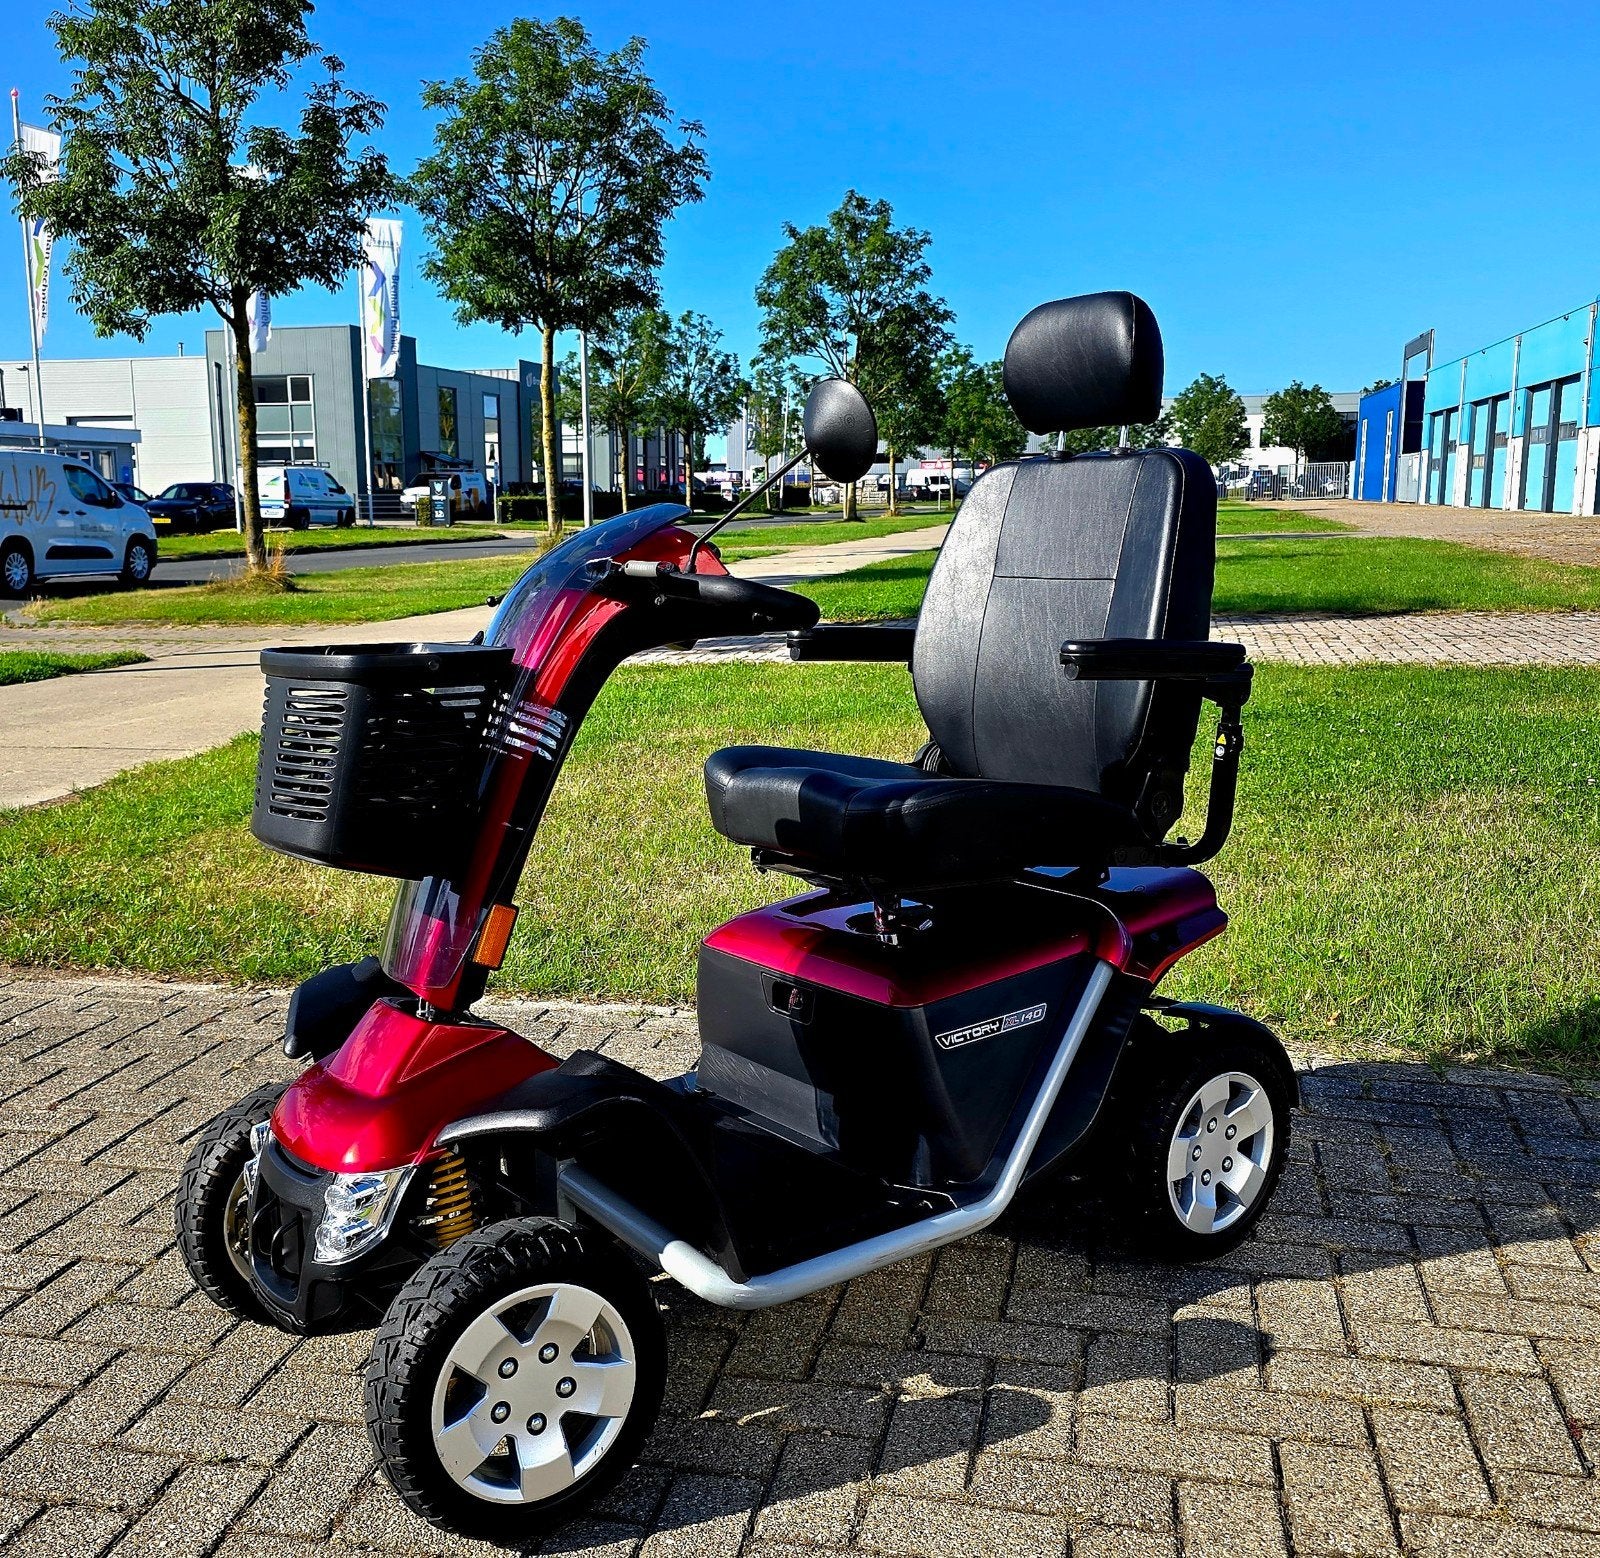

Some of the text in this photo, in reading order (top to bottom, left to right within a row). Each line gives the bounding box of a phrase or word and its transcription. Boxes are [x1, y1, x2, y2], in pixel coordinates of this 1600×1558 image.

[41, 263, 50, 318] Techniek
[260, 290, 269, 327] chniek
[390, 275, 400, 356] Breman Techniek
[941, 1021, 1000, 1046] VICTORY
[1021, 1008, 1043, 1022] 140
